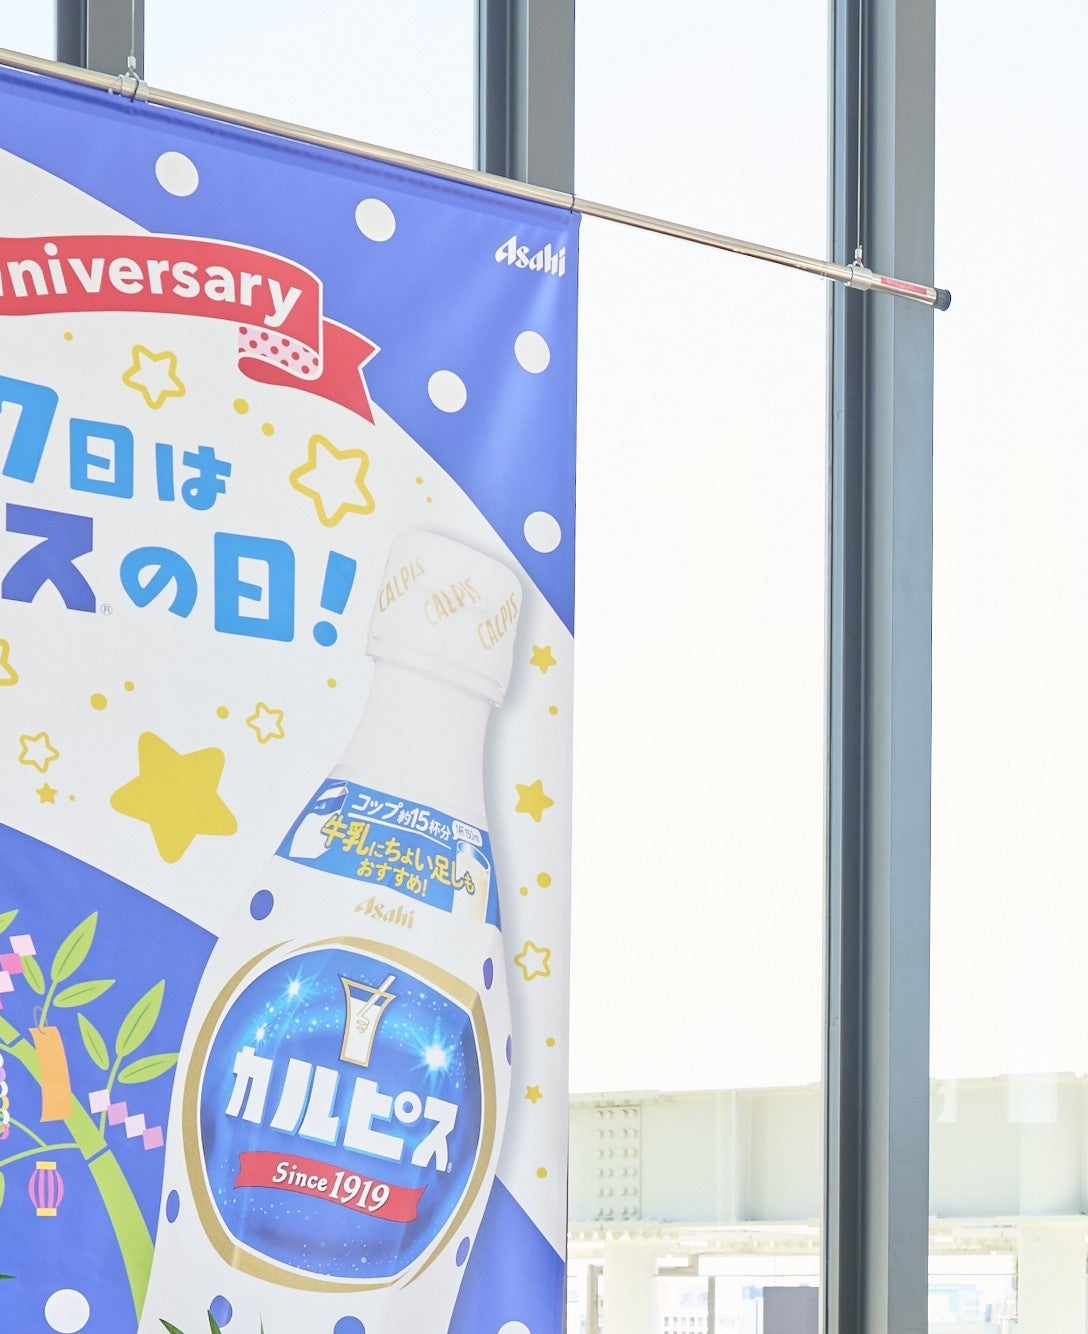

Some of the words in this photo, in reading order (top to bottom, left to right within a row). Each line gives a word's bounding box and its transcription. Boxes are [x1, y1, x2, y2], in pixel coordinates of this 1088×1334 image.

[495, 235, 566, 277] Asahi
[351, 793, 453, 841] コップ約15杯分
[354, 895, 416, 930] Asahi
[272, 1161, 328, 1192] Since
[329, 1170, 391, 1213] 1919
